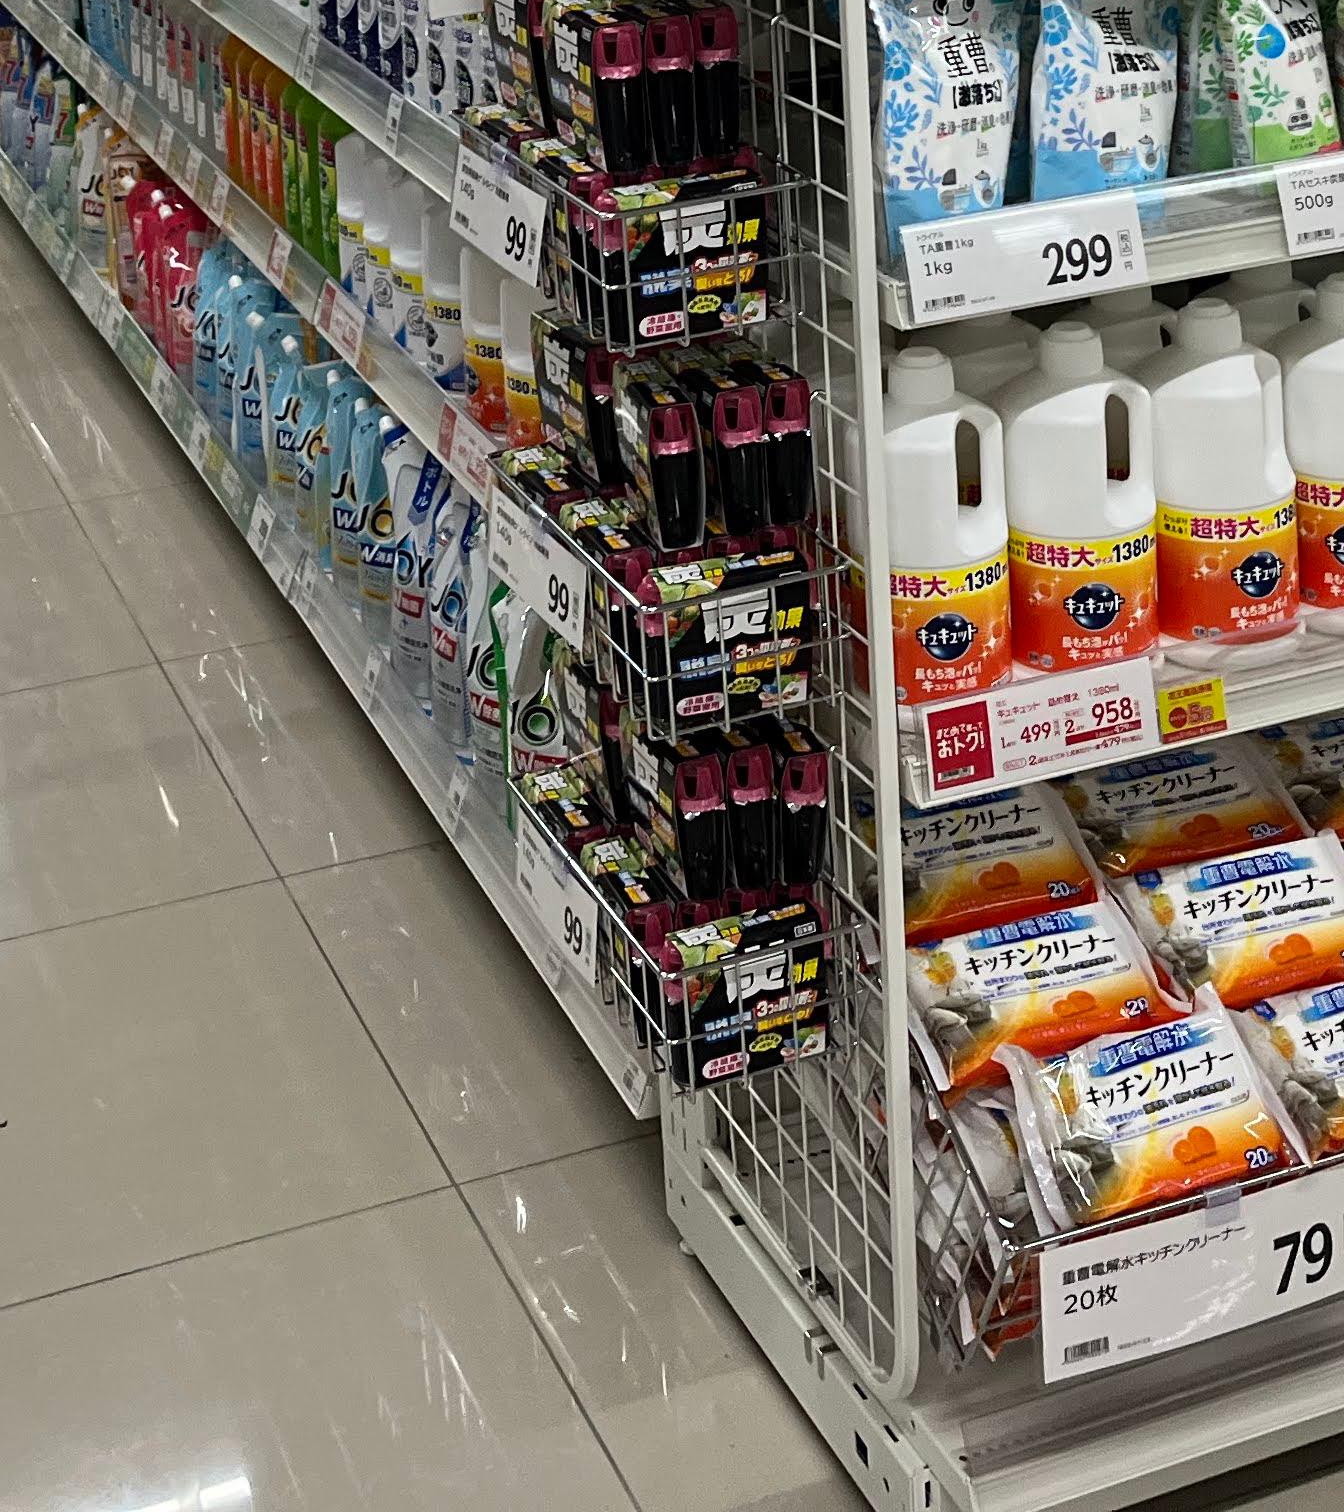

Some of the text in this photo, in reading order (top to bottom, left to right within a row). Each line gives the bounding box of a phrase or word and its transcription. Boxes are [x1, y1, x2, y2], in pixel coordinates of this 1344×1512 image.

[1090, 6, 1139, 48] 重曹
[937, 29, 994, 80] 重曹
[1293, 193, 1335, 212] 500g
[504, 215, 527, 262] 99
[923, 233, 1114, 287] 1kg 299
[1189, 514, 1261, 541] 超特大
[1025, 542, 1096, 570] 超特大
[1111, 536, 1150, 565] 1380
[964, 559, 1003, 592] 1380
[547, 573, 570, 622] 99
[1063, 592, 1125, 618] キュキュット
[916, 620, 979, 648] キュキュット
[1091, 696, 1134, 728] 958
[937, 736, 987, 760] おトク!
[1020, 722, 1053, 744] 499
[1182, 875, 1336, 920] キッチンクリーナー
[563, 904, 583, 953] 99
[963, 934, 1118, 976] キッチンクリーナー
[1084, 1051, 1235, 1108] キッチンクリーナー
[1063, 1219, 1336, 1316] 20枚 79
